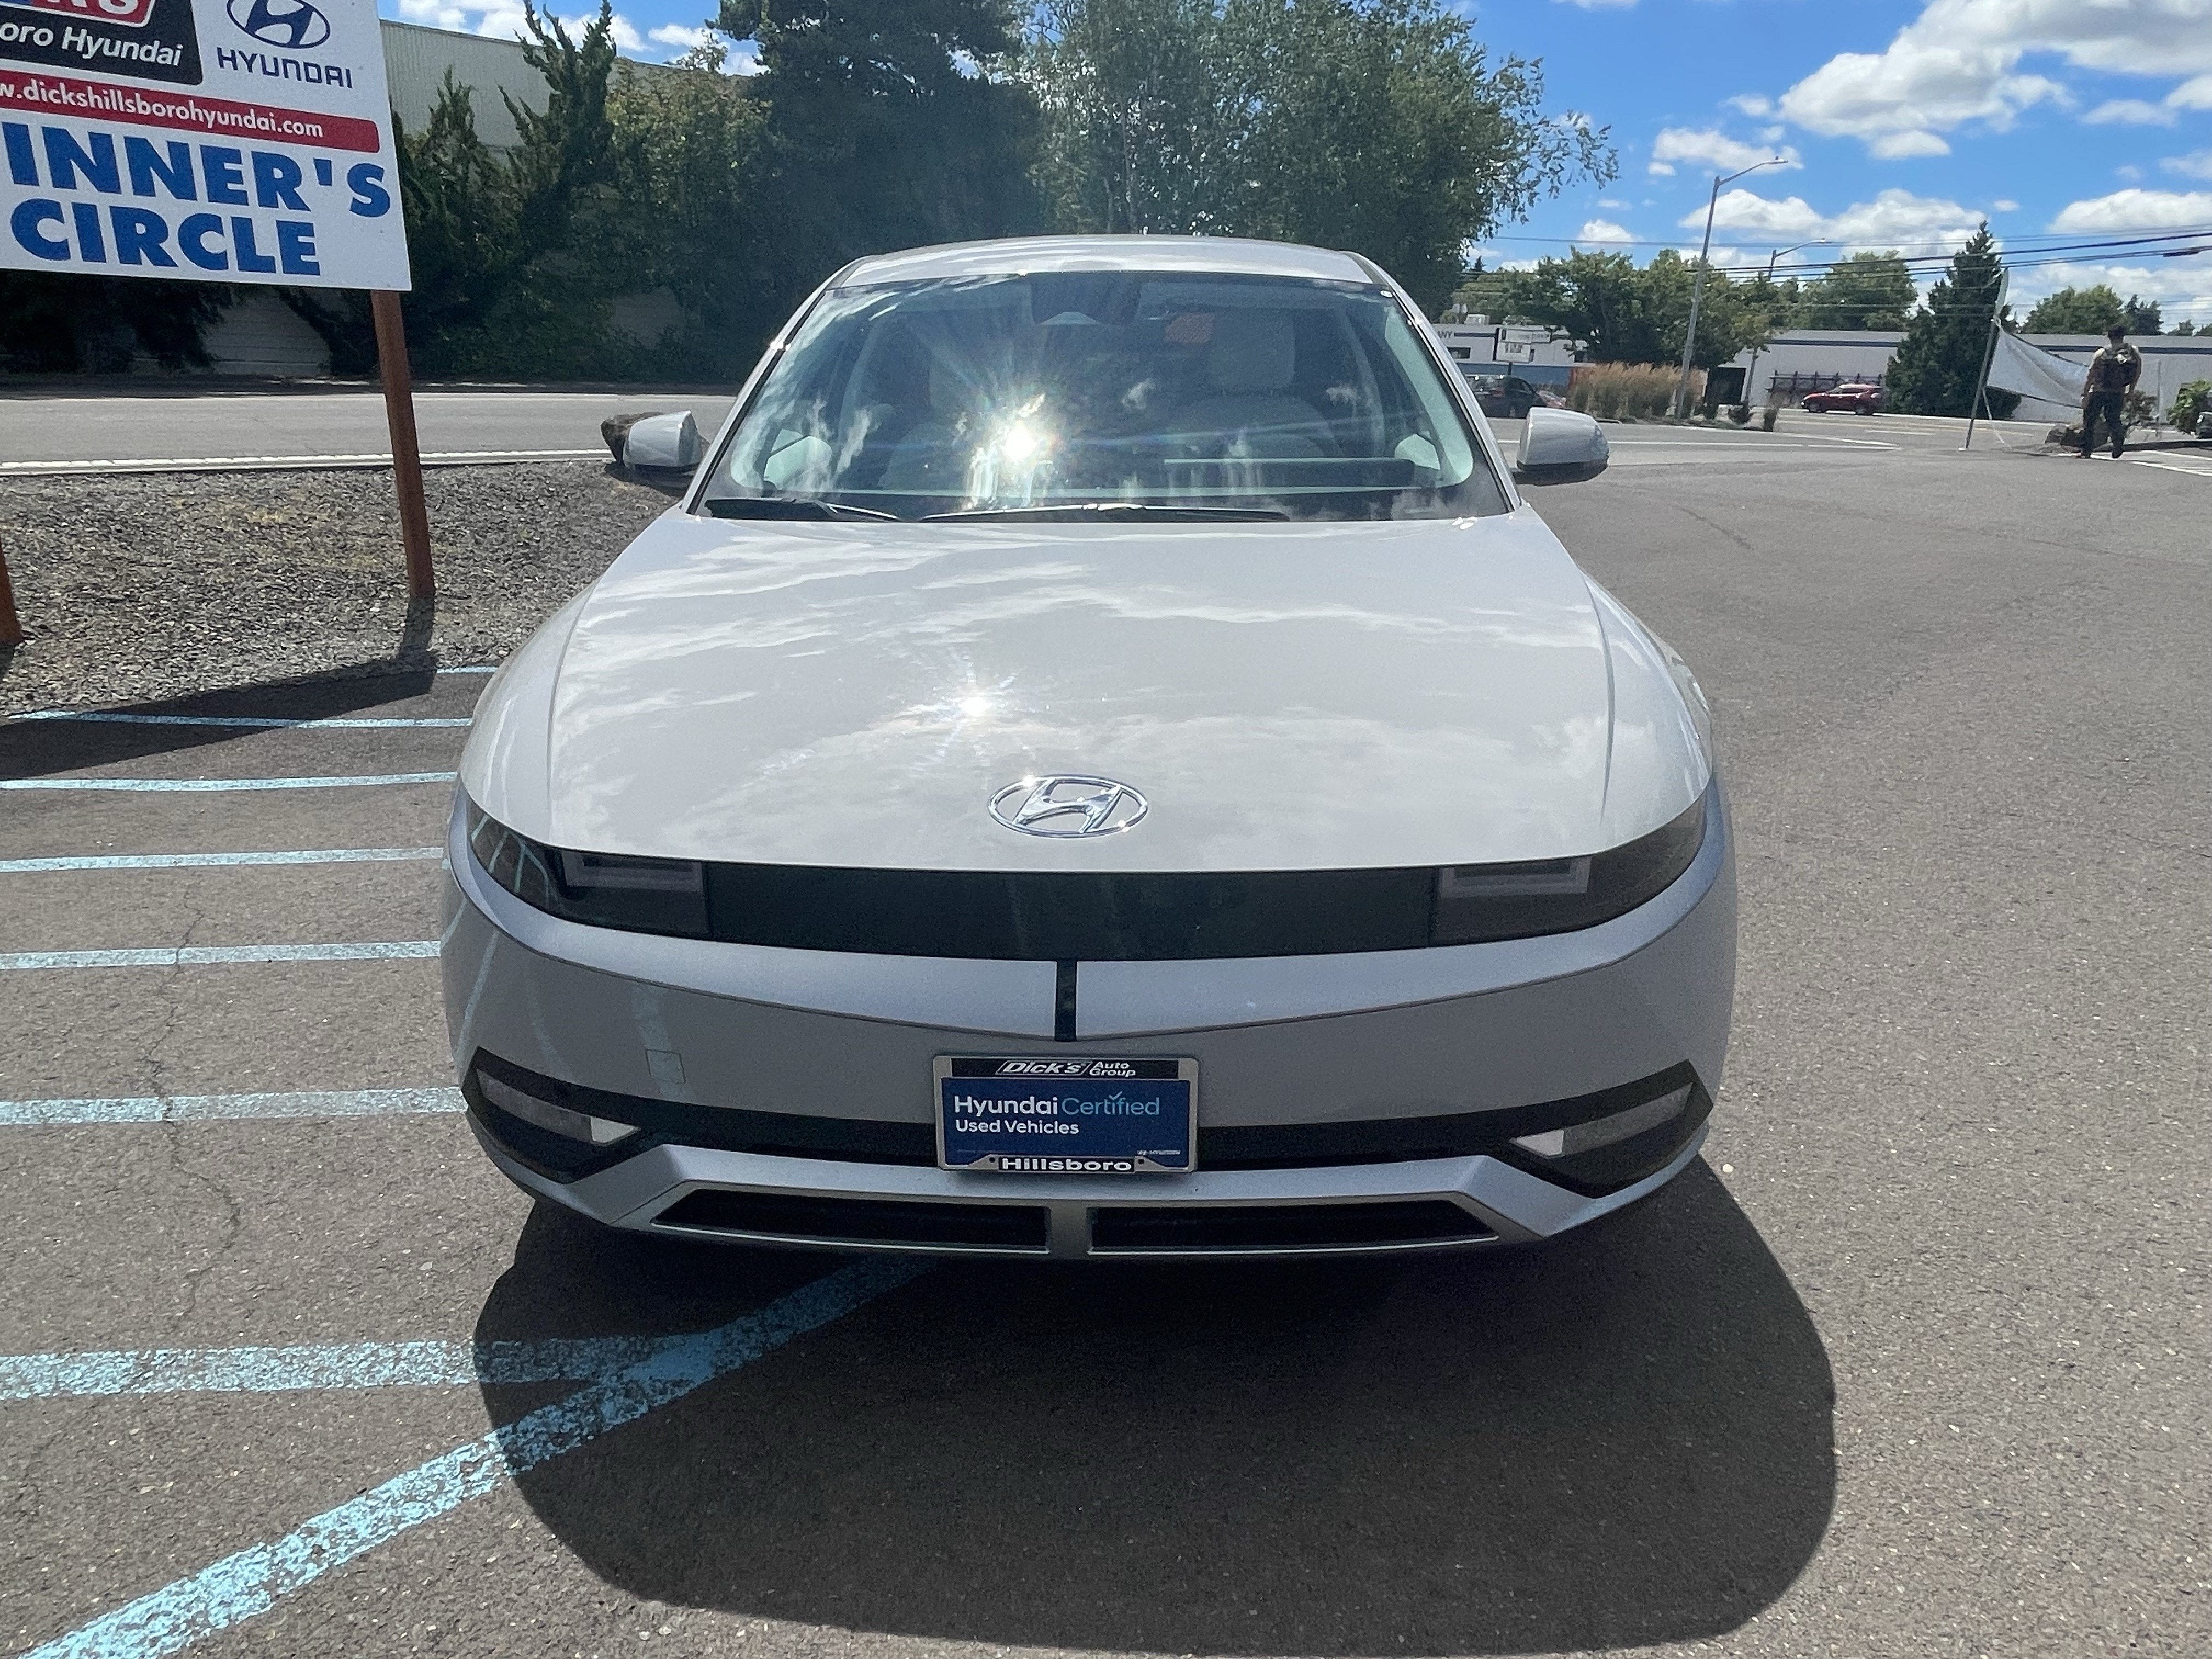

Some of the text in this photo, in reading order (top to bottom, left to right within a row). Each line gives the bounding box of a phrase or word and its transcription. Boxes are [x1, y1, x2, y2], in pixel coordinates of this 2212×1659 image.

[0, 22, 184, 67] oro Hyundai
[216, 47, 353, 89] HYUNDAI
[1, 122, 391, 218] INNER'S
[10, 198, 321, 276] CIRCLE
[1089, 1069, 1136, 1077] Group
[1093, 1061, 1130, 1069] Auto
[954, 1091, 1160, 1117] Hyundai Certified
[955, 1119, 1080, 1135] Used Vehicles
[1002, 1158, 1132, 1171] Hillsboro
